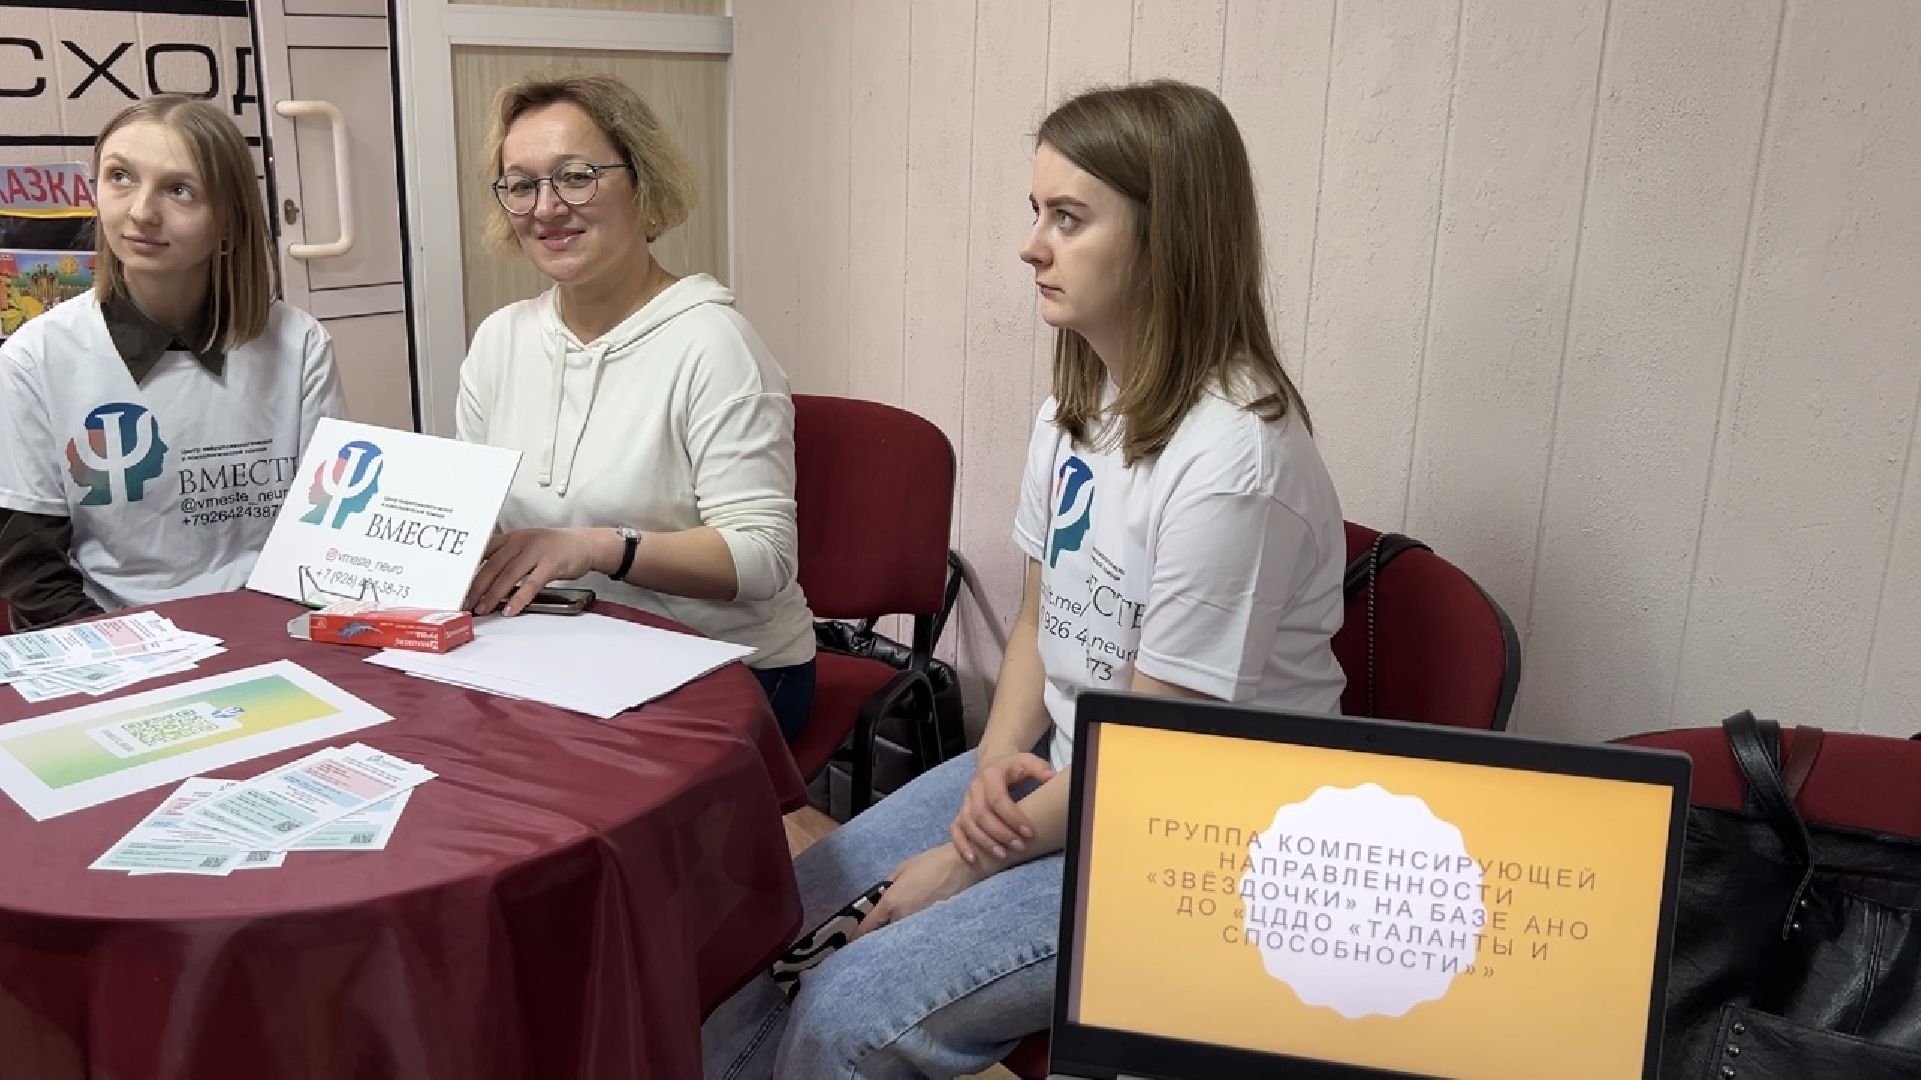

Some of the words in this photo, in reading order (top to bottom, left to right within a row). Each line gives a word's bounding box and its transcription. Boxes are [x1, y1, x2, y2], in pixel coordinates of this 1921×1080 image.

[182, 504, 283, 526] +7926424387
[365, 513, 469, 556] ВМЕСТЕ
[1148, 817, 1263, 849] ГРУППА
[1278, 833, 1596, 890] КОМПЕНСИРУЮЩЕЙ
[1219, 851, 1513, 906] НАПРАВЛЕННОСТИ
[1146, 868, 1357, 909] «ЗВЁЗДОЧКИ»
[1375, 896, 1414, 919] НА
[1430, 902, 1508, 930] БАЗЕ
[1523, 915, 1589, 940] АНО
[1176, 895, 1217, 917] ДО
[1233, 903, 1332, 933] «ЦДДО
[1348, 918, 1513, 956] «ТАЛАНТЫ
[1531, 941, 1549, 961] И
